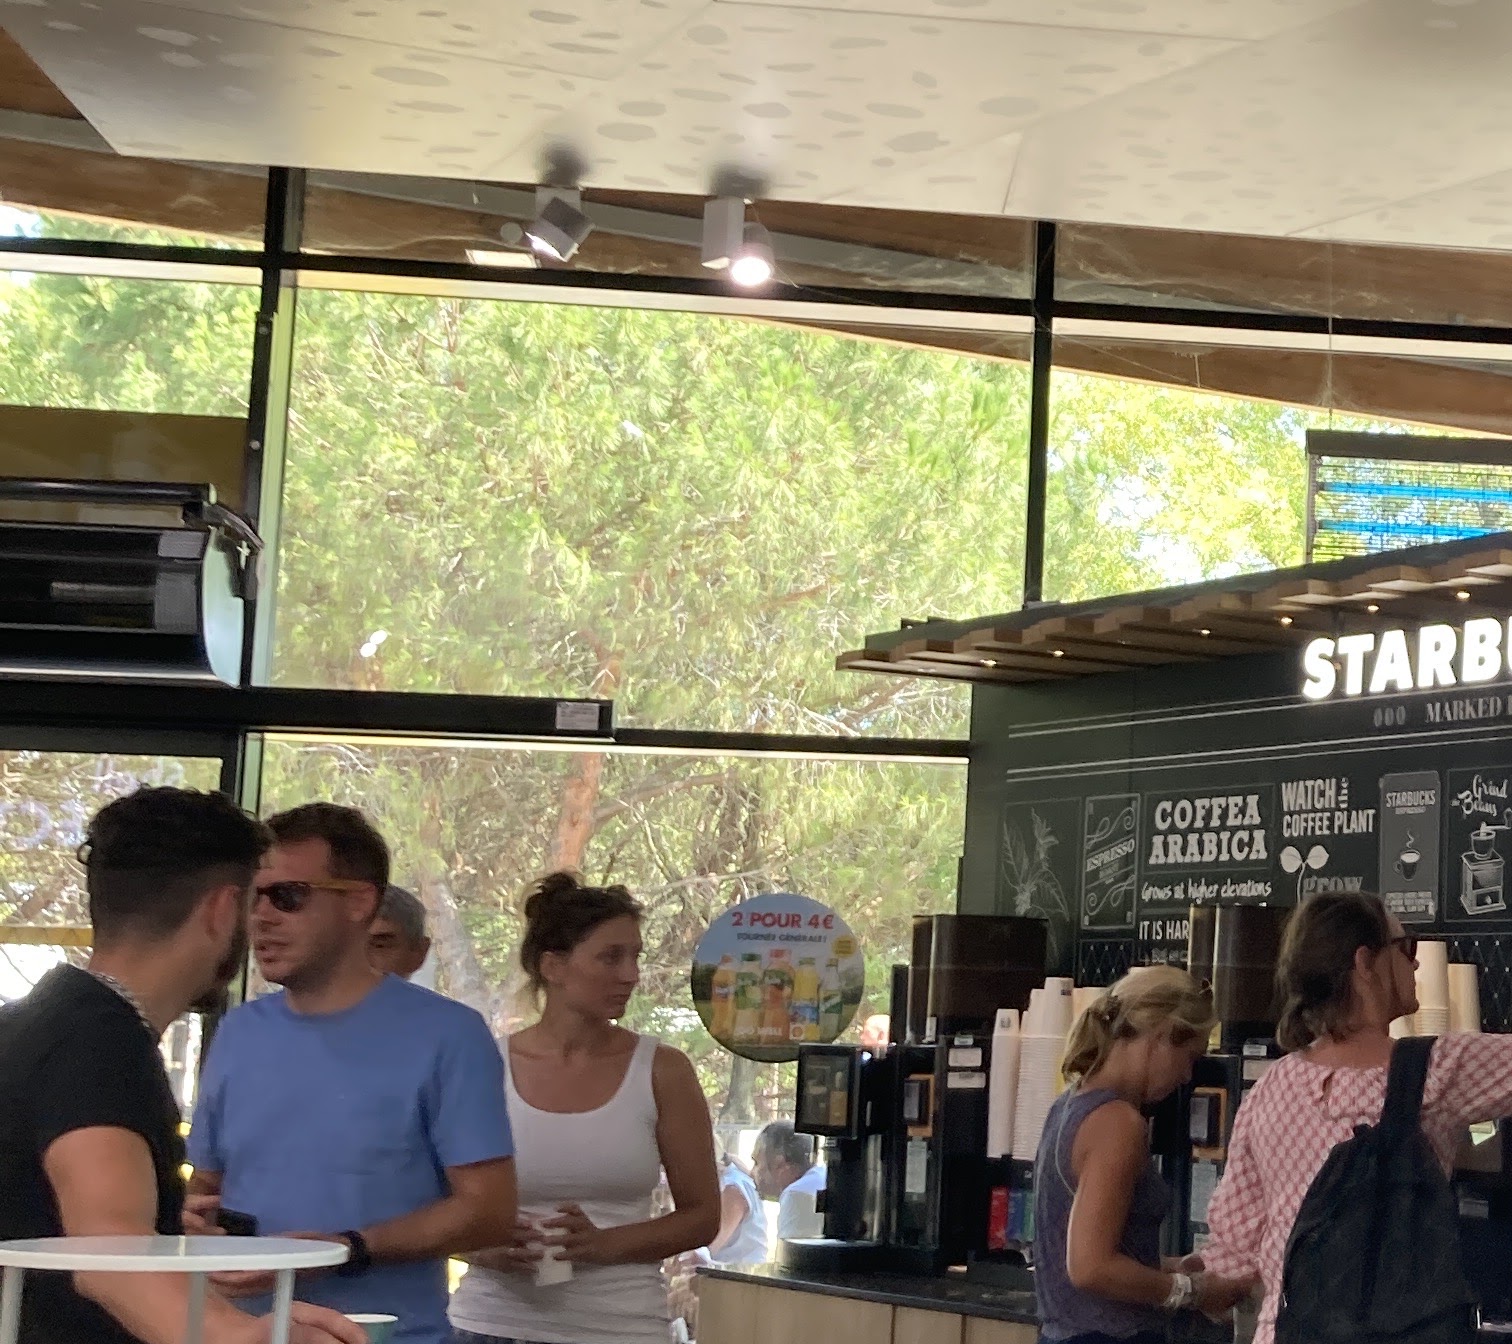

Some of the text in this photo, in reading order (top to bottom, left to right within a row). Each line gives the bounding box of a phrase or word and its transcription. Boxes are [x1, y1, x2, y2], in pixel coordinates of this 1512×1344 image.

[1425, 696, 1501, 723] MARKED
[1281, 777, 1337, 811] WATCH
[1385, 790, 1436, 807] STARBUCKS
[1472, 774, 1509, 800] Grind
[1154, 794, 1262, 831] COFFEA
[1282, 808, 1376, 838] COFFEE PLANT
[1148, 829, 1268, 865] ARABICA
[1141, 877, 1272, 904] Grows at higher elevations
[731, 911, 743, 927] 2
[749, 911, 803, 928] POUR
[1138, 919, 1190, 940] IT IS HAR
